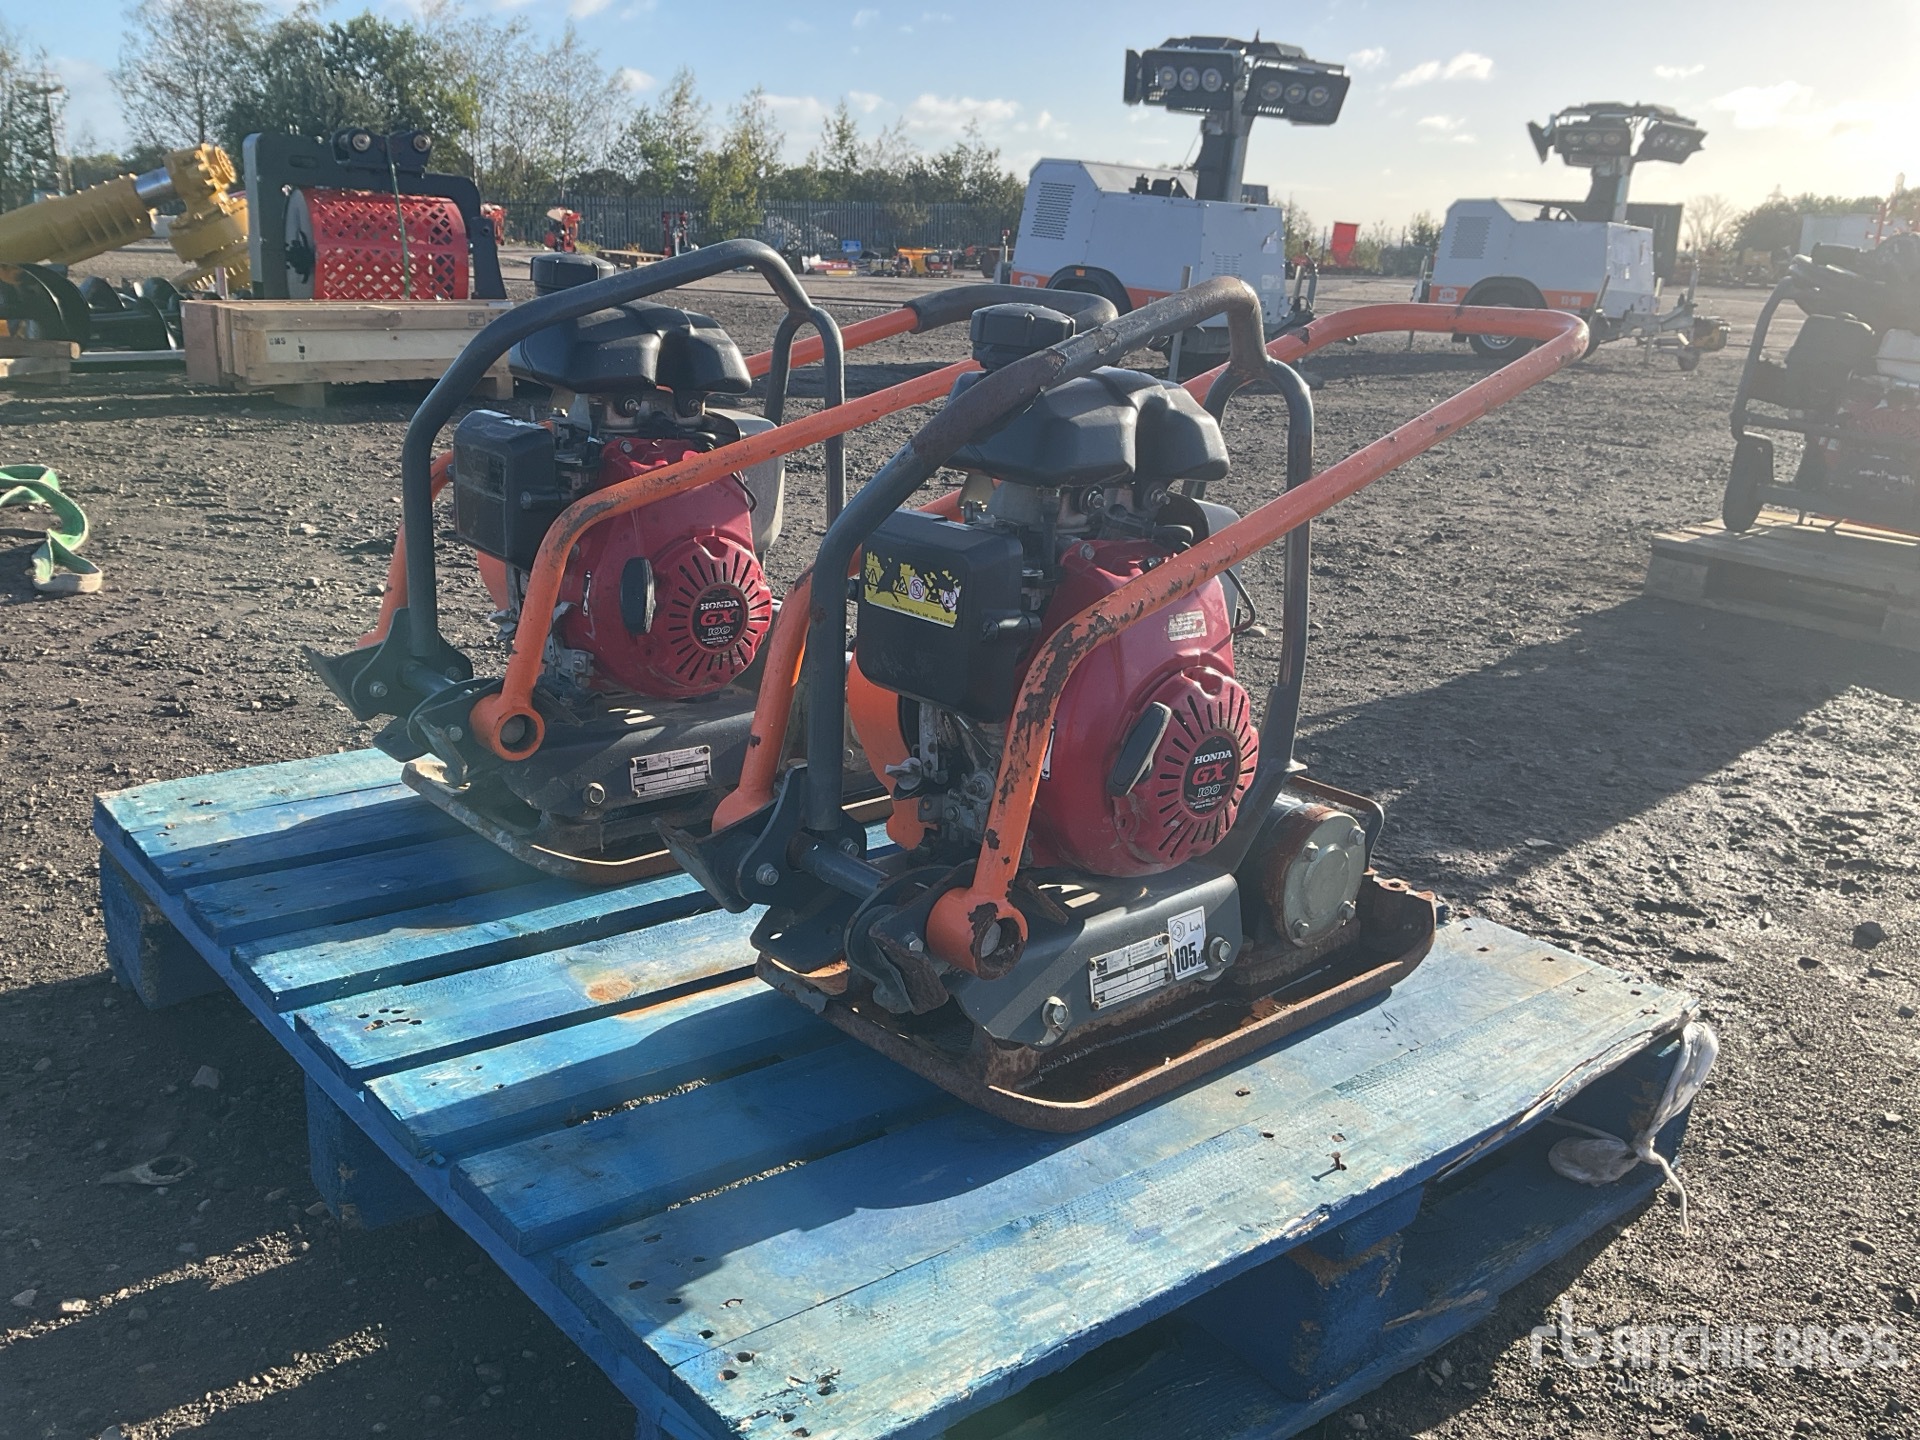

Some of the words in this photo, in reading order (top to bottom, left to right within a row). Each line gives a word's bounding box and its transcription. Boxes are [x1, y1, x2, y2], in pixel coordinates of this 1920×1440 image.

[700, 600, 739, 610] HONDA
[701, 609, 735, 626] GX
[708, 625, 730, 636] 100
[1194, 750, 1232, 764] HONDA
[1192, 762, 1229, 785] GX
[1198, 784, 1220, 797] 100
[1174, 942, 1197, 972] 105
